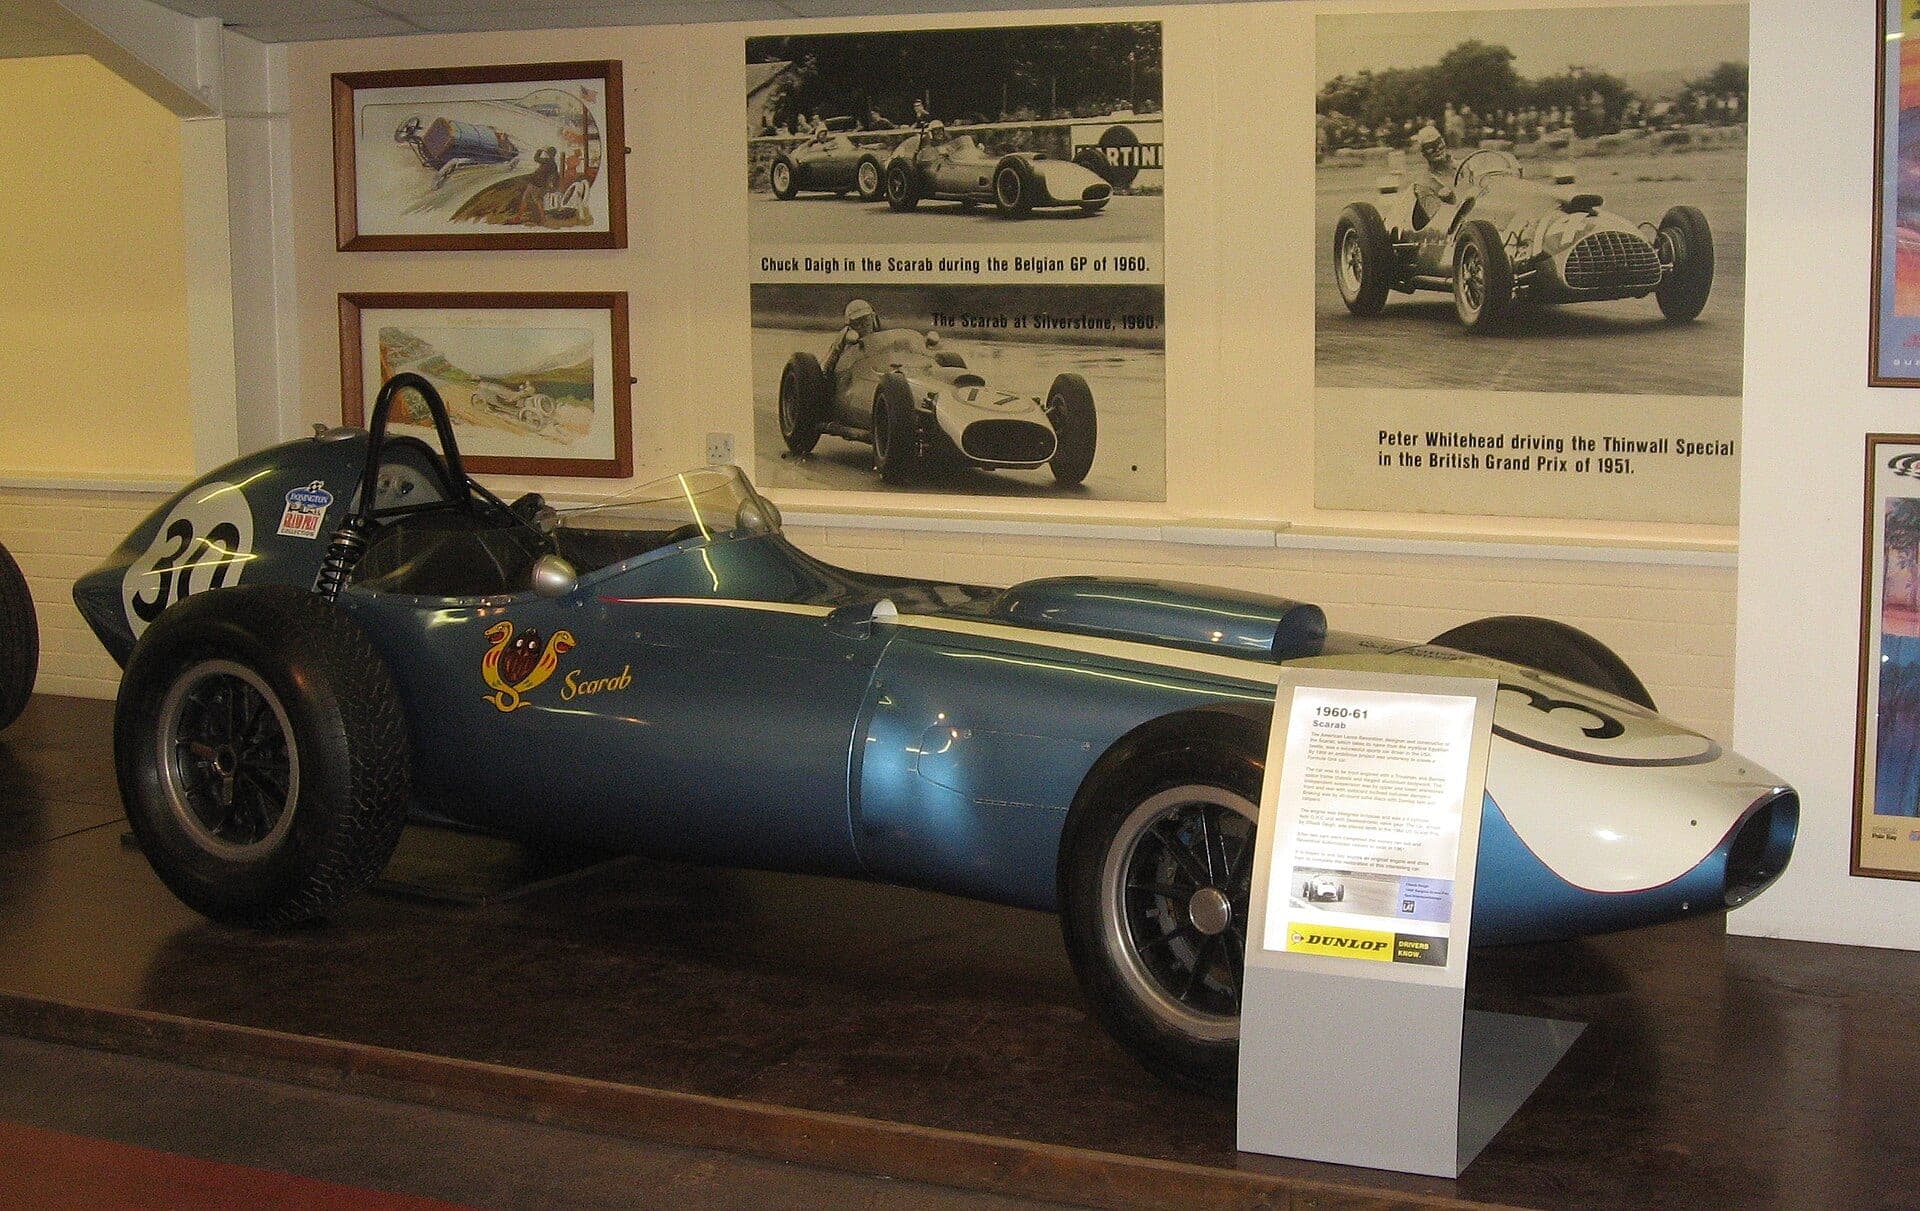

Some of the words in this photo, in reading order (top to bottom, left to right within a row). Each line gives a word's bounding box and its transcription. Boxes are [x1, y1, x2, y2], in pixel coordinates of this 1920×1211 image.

[761, 257, 799, 272] Chuck
[805, 257, 840, 274] Daigh
[844, 257, 856, 272] in
[862, 257, 882, 272] the
[888, 257, 933, 272] Scarab
[939, 257, 980, 274] during
[987, 257, 1008, 272] the
[1014, 256, 1064, 274] Belgian
[1070, 256, 1088, 272] GP
[1093, 256, 1107, 272] of
[1114, 256, 1150, 272] 1960.
[930, 312, 955, 327] The
[962, 314, 1008, 329] Scarab
[1014, 315, 1027, 329] at
[1033, 314, 1117, 331] Silverstone,
[1122, 315, 1158, 330] 1960.
[1378, 430, 1419, 446] Peter
[1425, 431, 1504, 449] Whitehead
[1511, 434, 1564, 453] driving
[1572, 436, 1596, 452] the
[1603, 436, 1668, 454] Thinwall
[1676, 438, 1734, 457] Special
[1378, 451, 1391, 467] in
[1399, 452, 1422, 468] the
[1429, 453, 1479, 469] British
[1485, 454, 1530, 471] Grand
[1537, 456, 1567, 472] Prix
[1575, 457, 1590, 473] of
[1598, 458, 1635, 474] 1951.
[561, 665, 632, 700] Scarab
[1316, 706, 1368, 719] 1960-61
[1312, 720, 1346, 729] Scarab
[1306, 935, 1388, 951] DUNLOP
[1398, 940, 1430, 950] DRIVERS
[1397, 950, 1422, 958] KNOW.
